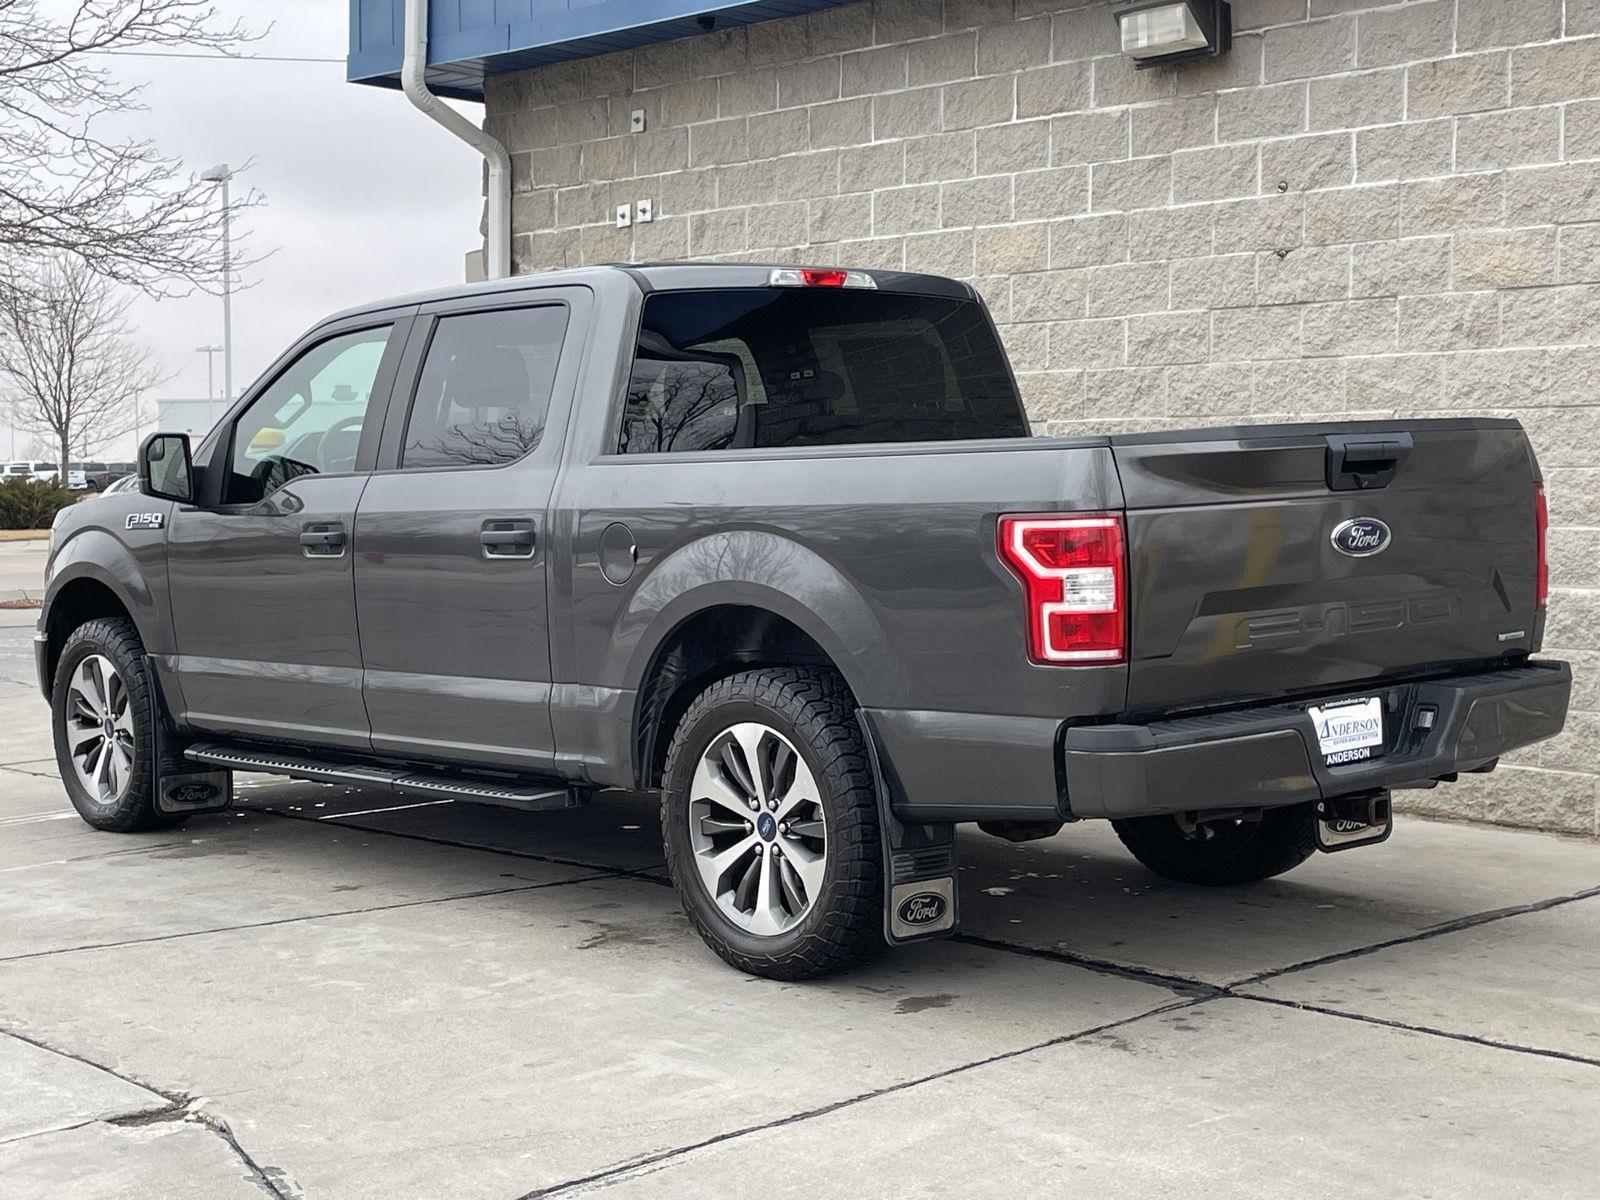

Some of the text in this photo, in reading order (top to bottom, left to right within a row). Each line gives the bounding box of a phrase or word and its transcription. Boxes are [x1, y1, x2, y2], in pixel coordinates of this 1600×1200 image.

[1348, 525, 1380, 549] Ford
[1321, 718, 1379, 739] ANDERSON
[1326, 747, 1370, 765] ANDERSON
[178, 785, 210, 801] Ford
[907, 897, 939, 921] Ford
